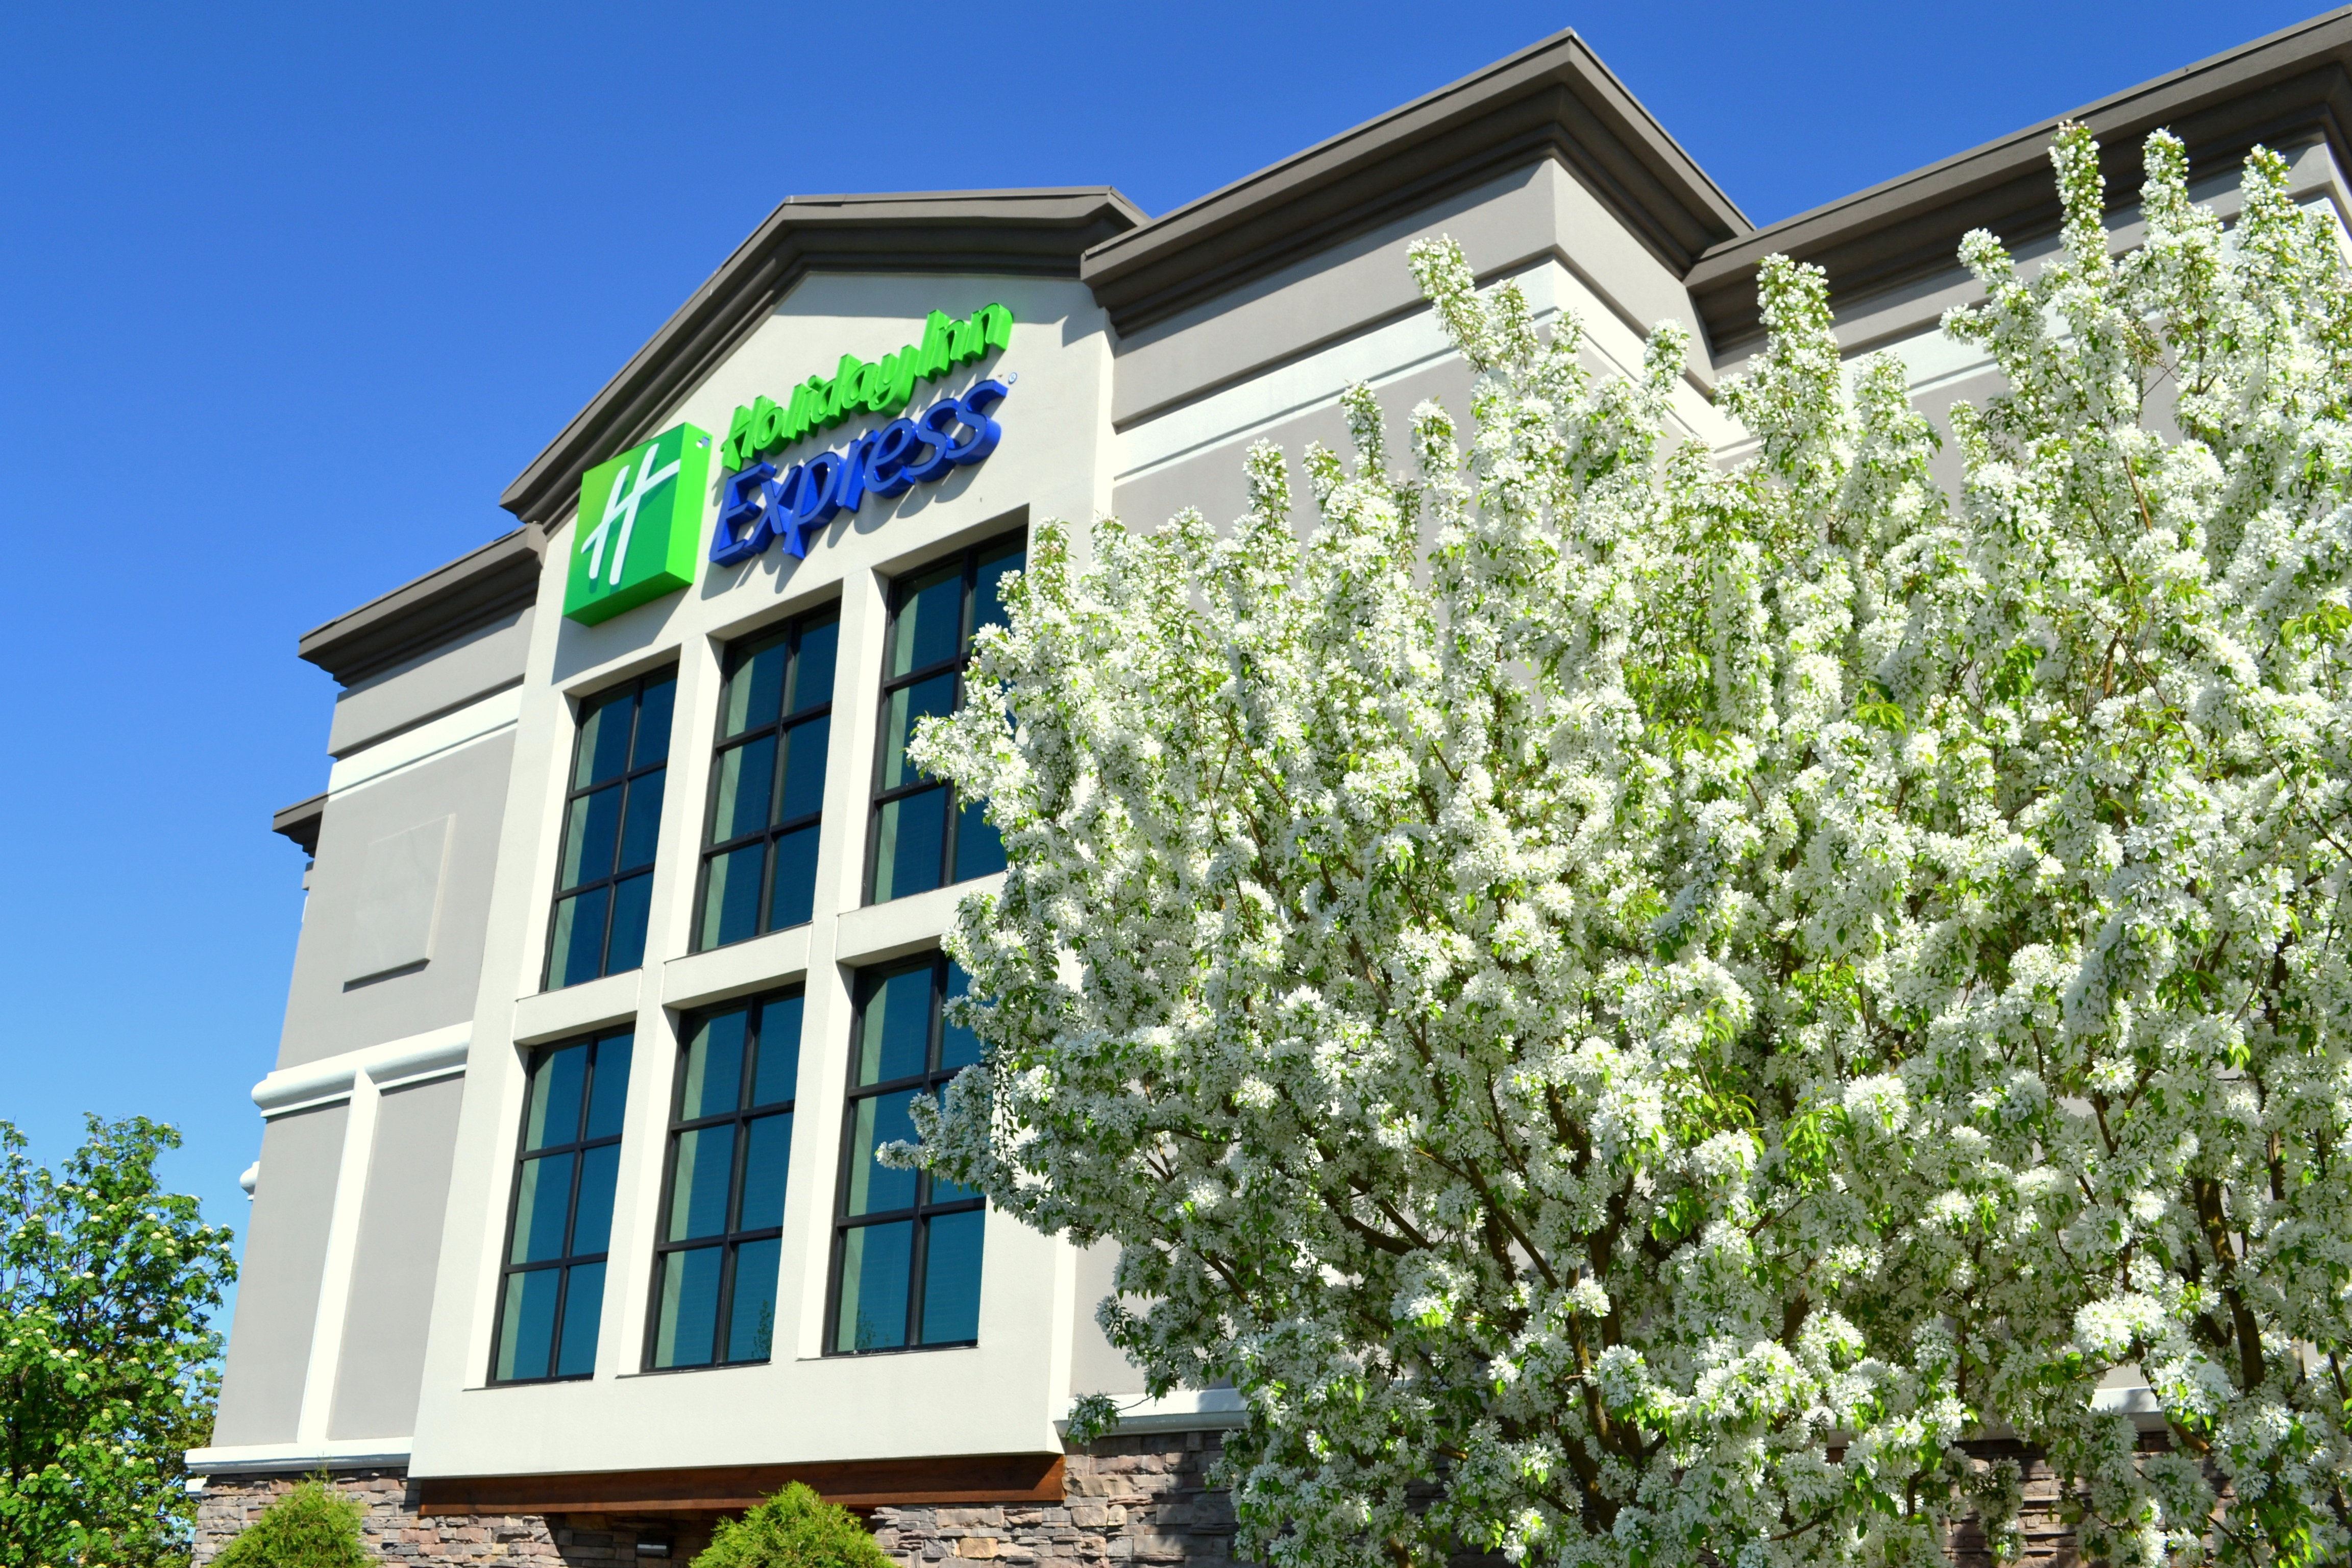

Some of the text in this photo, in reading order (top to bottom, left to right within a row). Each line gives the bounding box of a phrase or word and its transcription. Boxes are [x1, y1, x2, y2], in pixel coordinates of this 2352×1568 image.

[721, 303, 1013, 472] Holiday Inn
[581, 443, 681, 585] H
[708, 380, 1008, 568] Express
